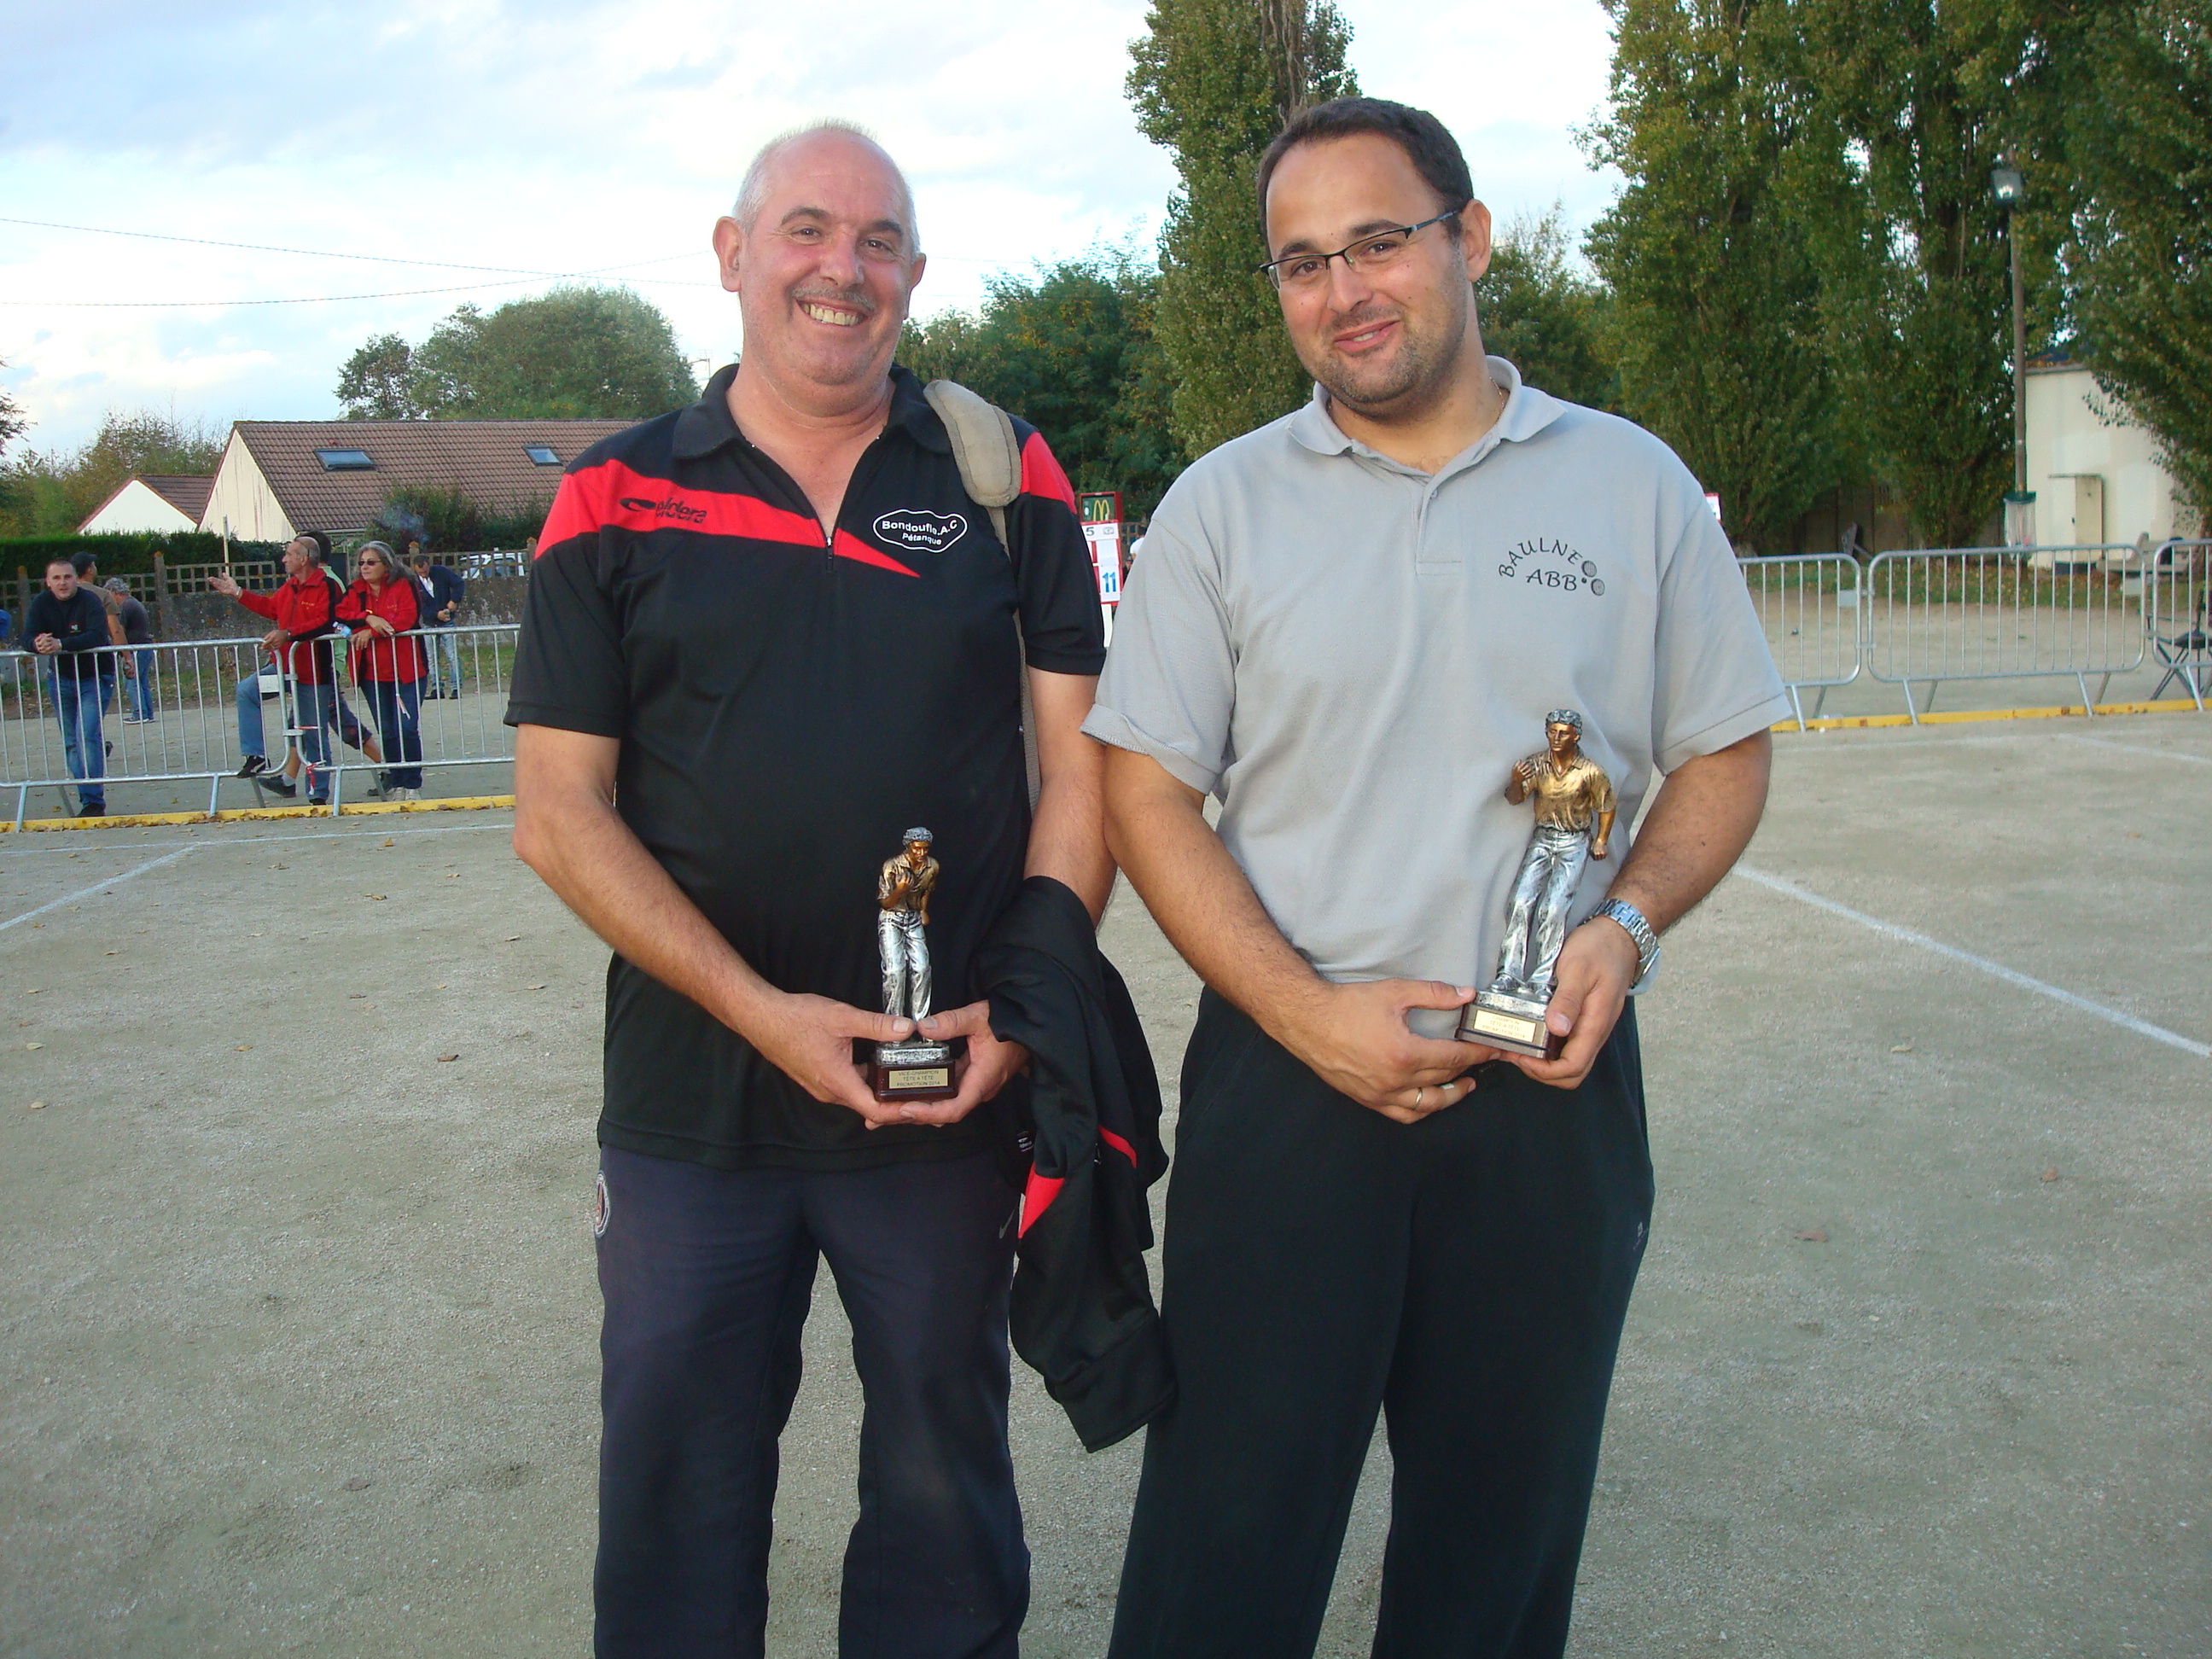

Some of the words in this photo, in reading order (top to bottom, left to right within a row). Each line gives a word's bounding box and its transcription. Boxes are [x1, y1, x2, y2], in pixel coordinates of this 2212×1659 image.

[1086, 527, 1095, 536] 5
[1499, 537, 1583, 578] BAULNE
[1102, 571, 1117, 593] 11
[1526, 568, 1577, 591] ABB
